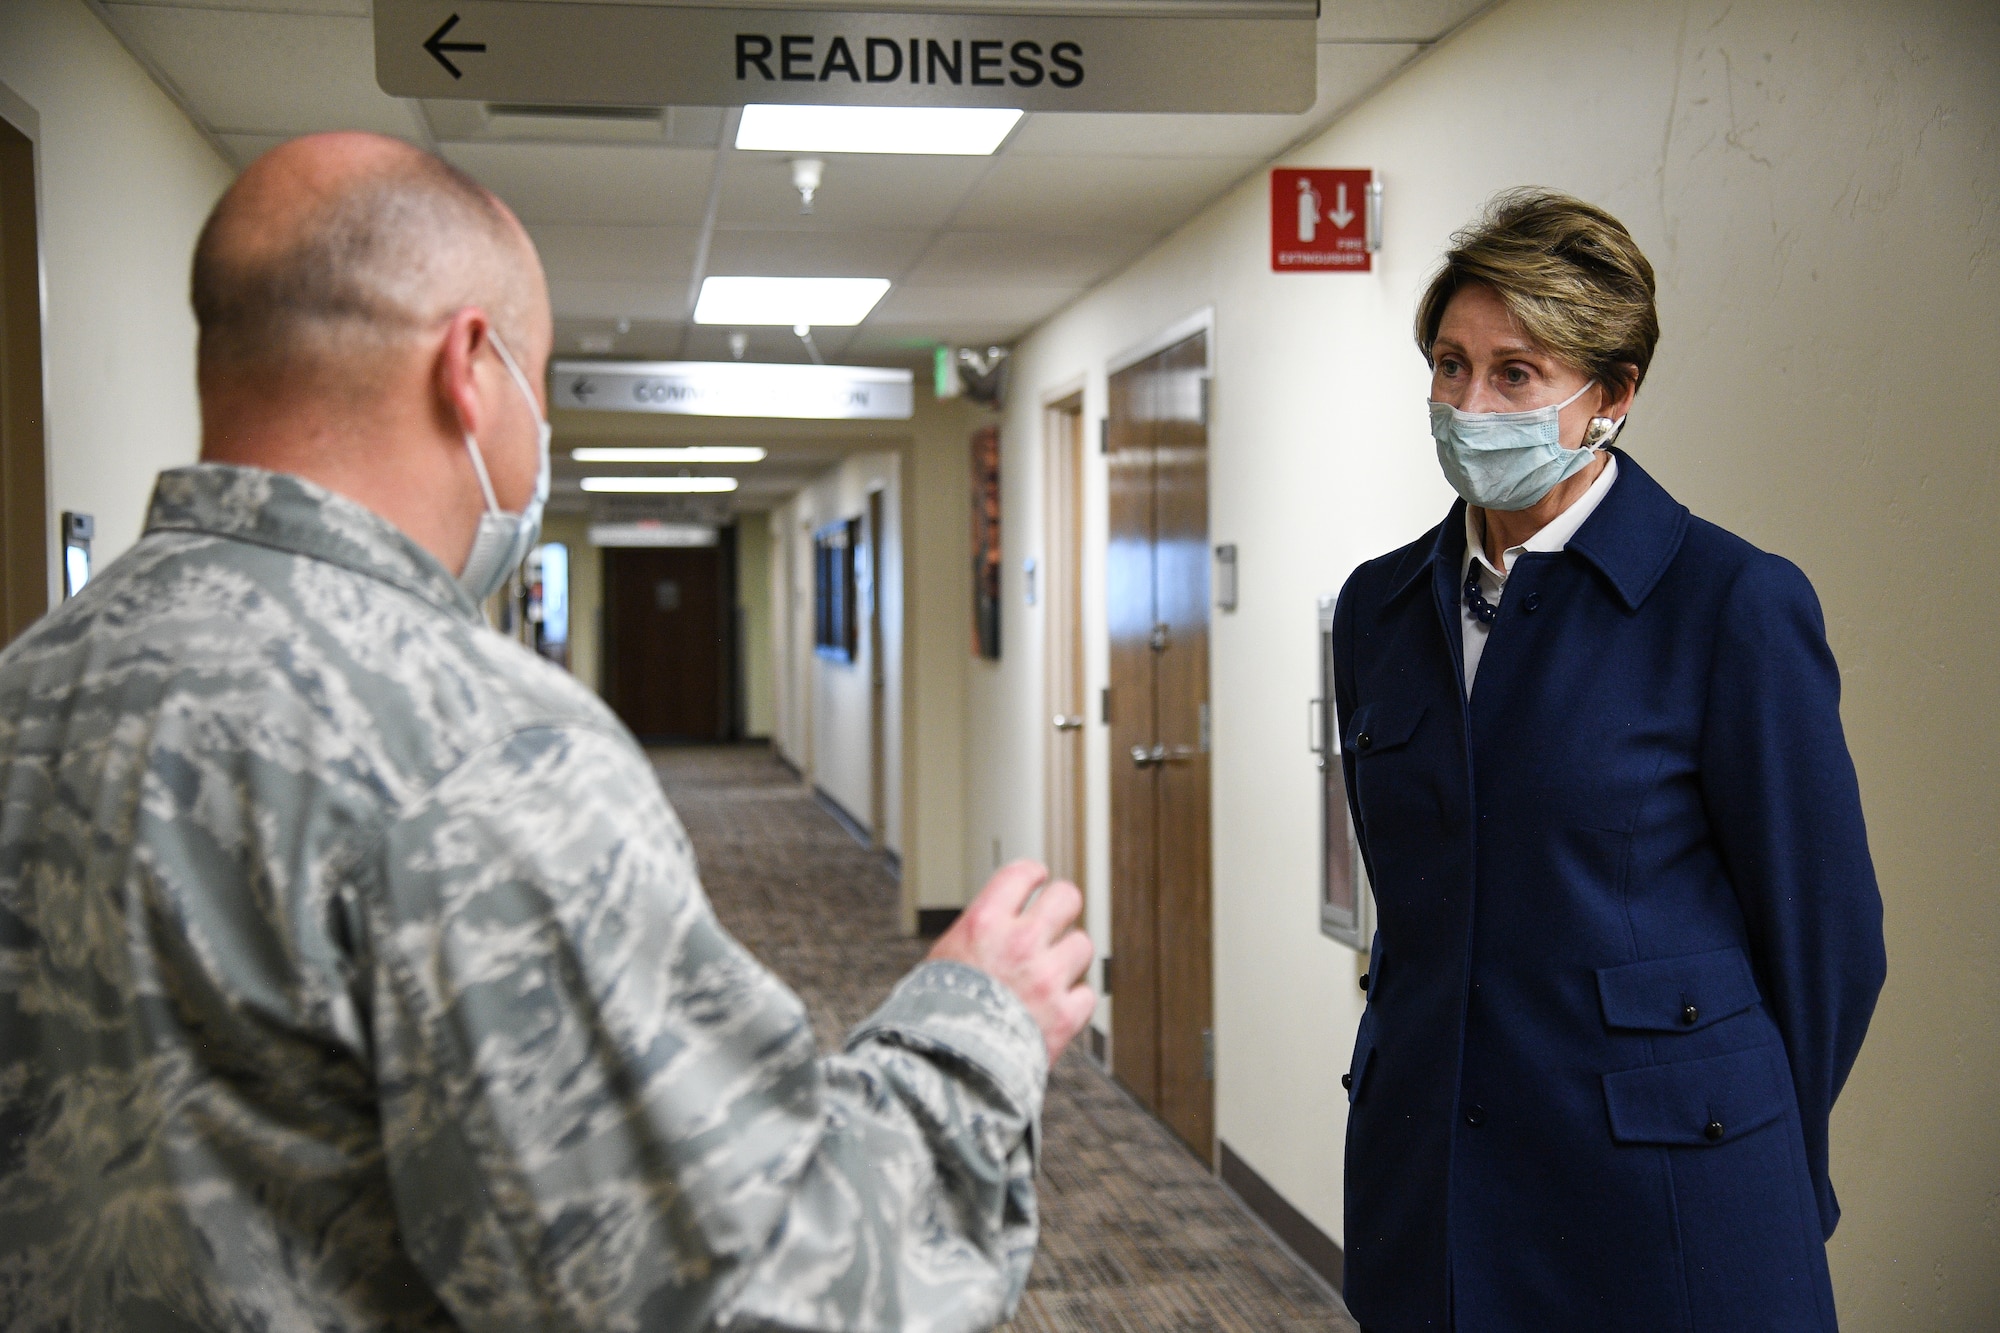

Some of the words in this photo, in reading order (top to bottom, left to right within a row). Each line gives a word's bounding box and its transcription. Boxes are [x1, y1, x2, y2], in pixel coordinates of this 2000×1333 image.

[735, 33, 1085, 88] READINESS
[1337, 239, 1363, 249] FIRE
[1279, 252, 1365, 265] EXTINGUISHER
